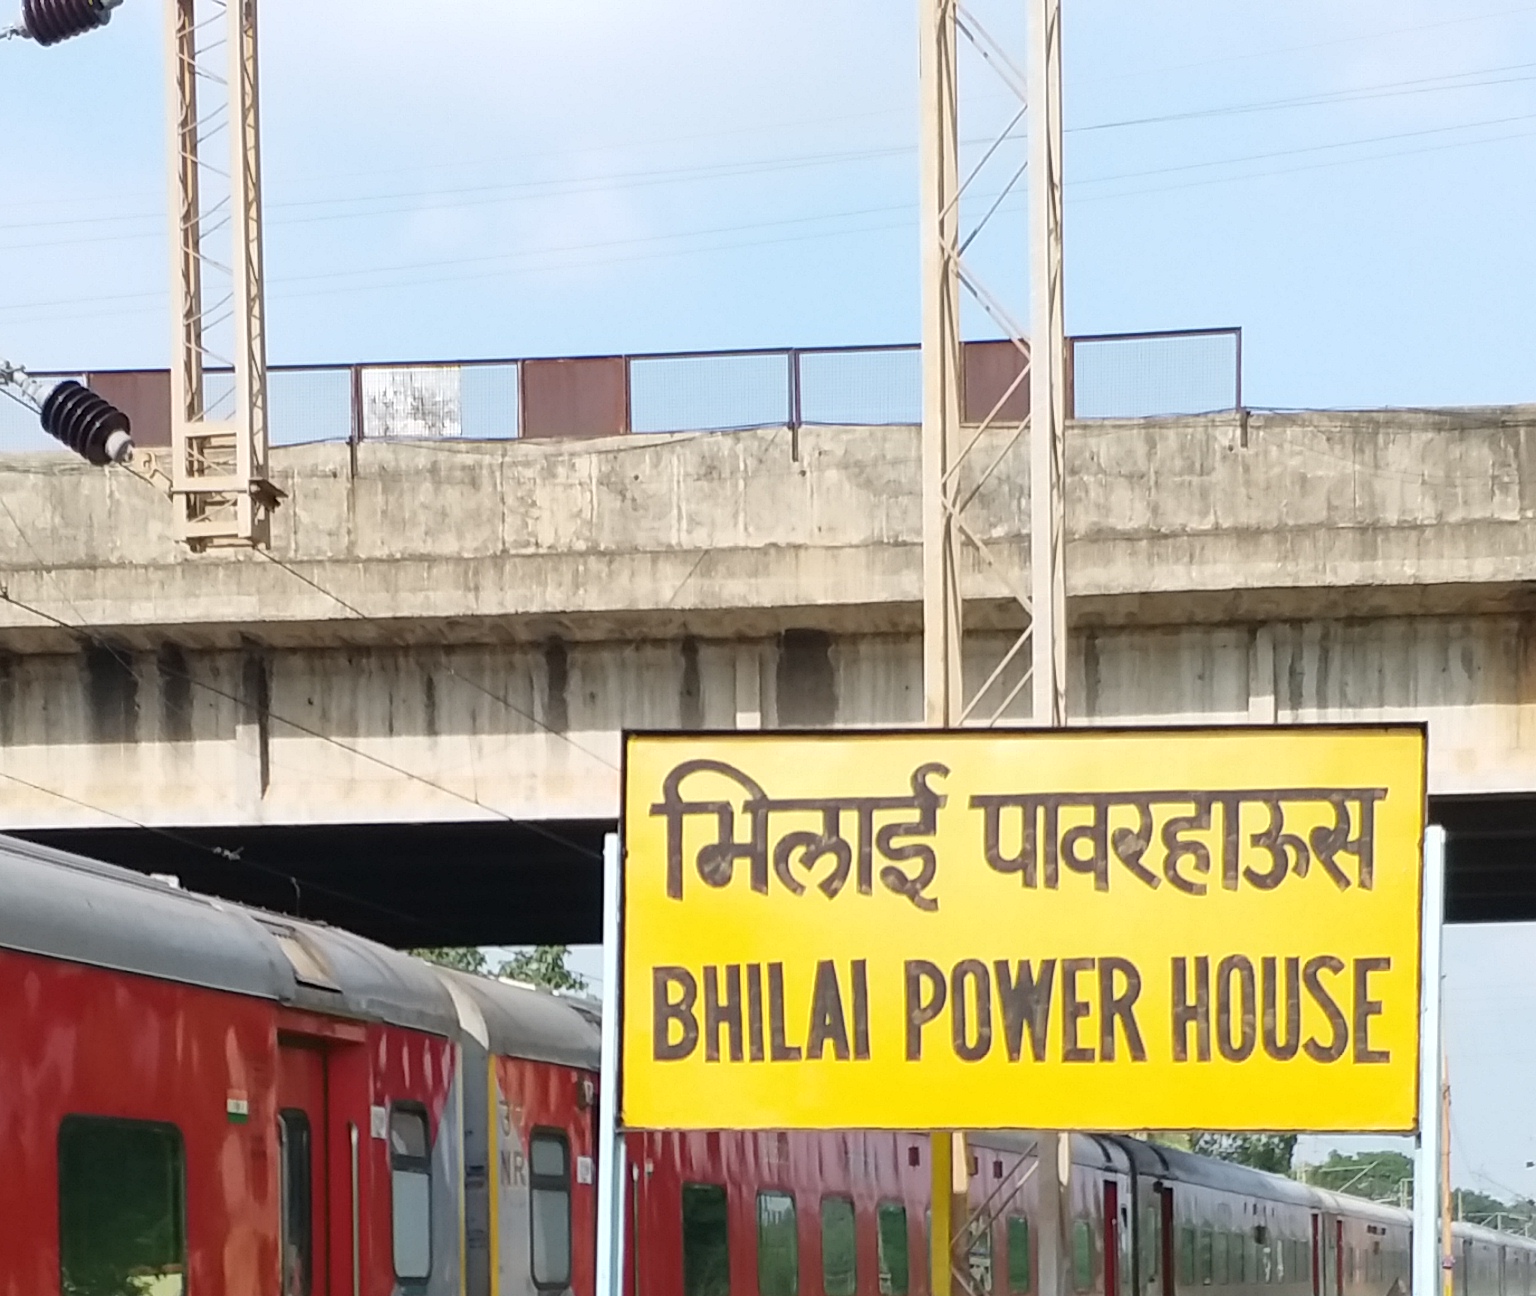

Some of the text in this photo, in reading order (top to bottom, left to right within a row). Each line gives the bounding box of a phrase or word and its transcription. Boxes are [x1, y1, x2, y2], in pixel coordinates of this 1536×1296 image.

[649, 758, 1389, 912] भिलाई पावरहाऊस
[651, 954, 1392, 1064] BHILAI POWER HOUSE
[500, 1150, 527, 1187] NR
